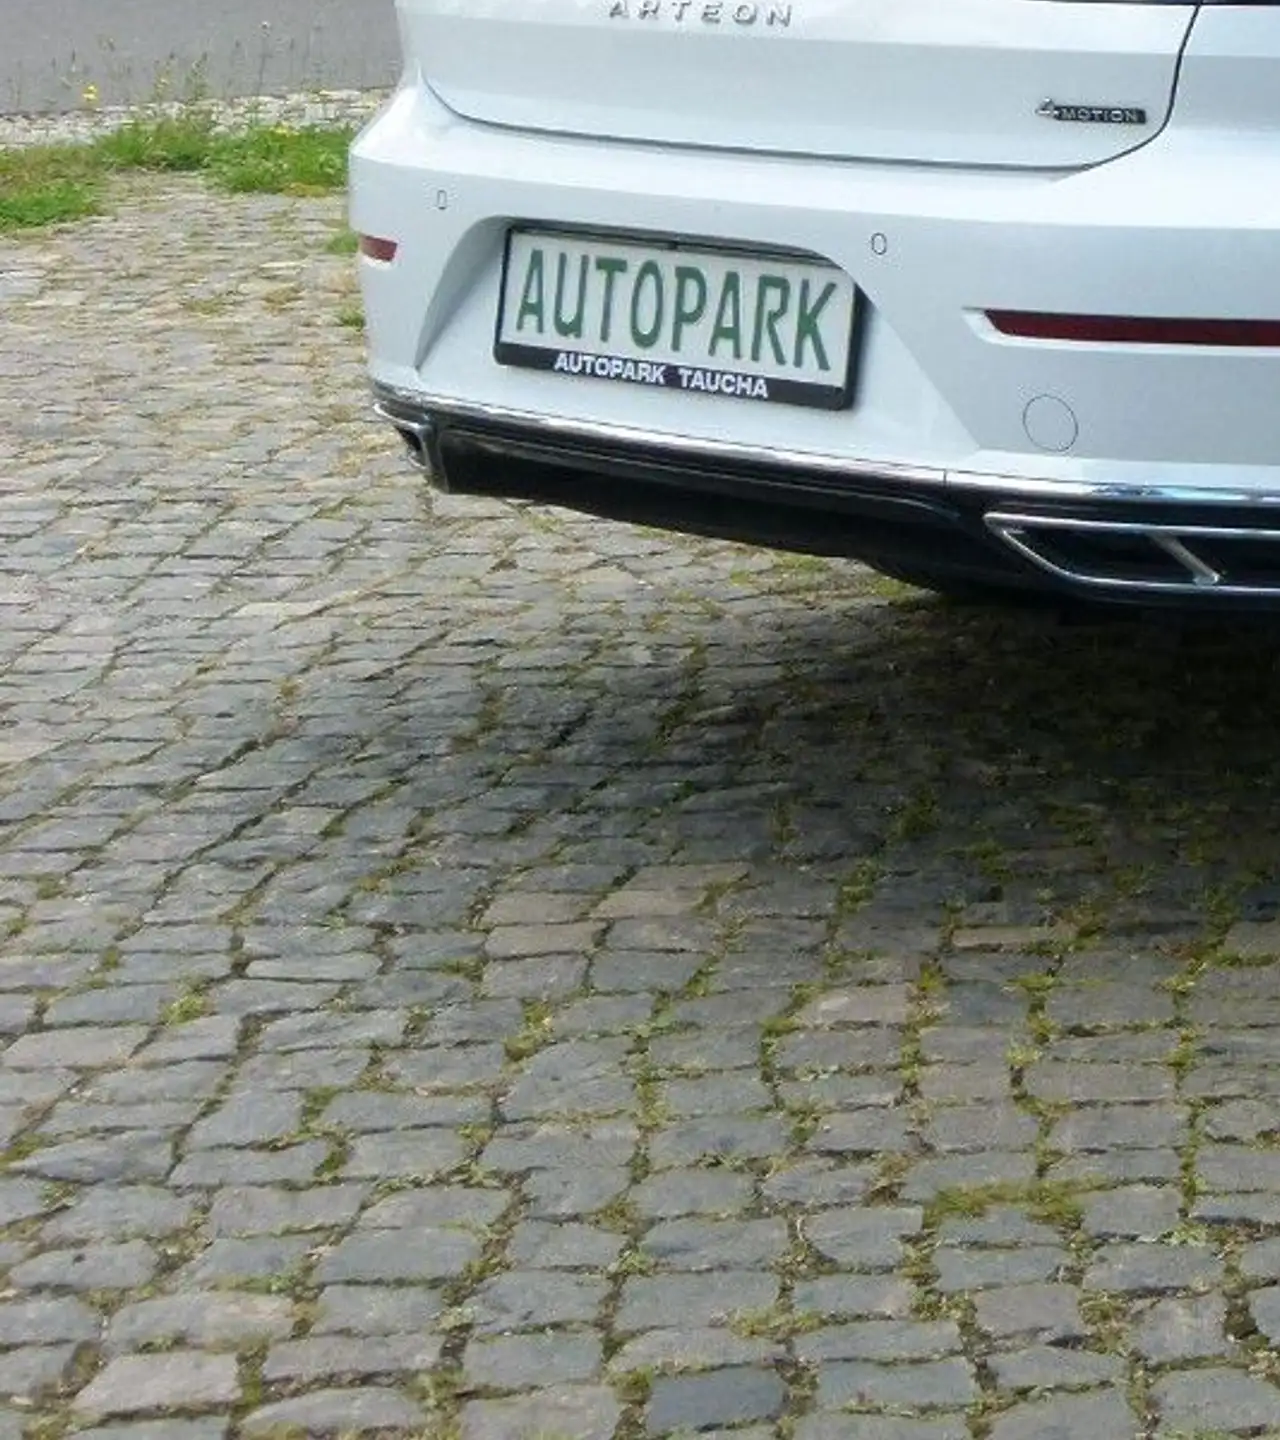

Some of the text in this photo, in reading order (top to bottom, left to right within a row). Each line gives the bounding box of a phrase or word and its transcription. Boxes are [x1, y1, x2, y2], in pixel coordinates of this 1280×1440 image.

[609, 0, 792, 28] ARTEON
[516, 249, 837, 371] AUTOPARK
[554, 352, 769, 399] AUTOPARK TAUCHA
